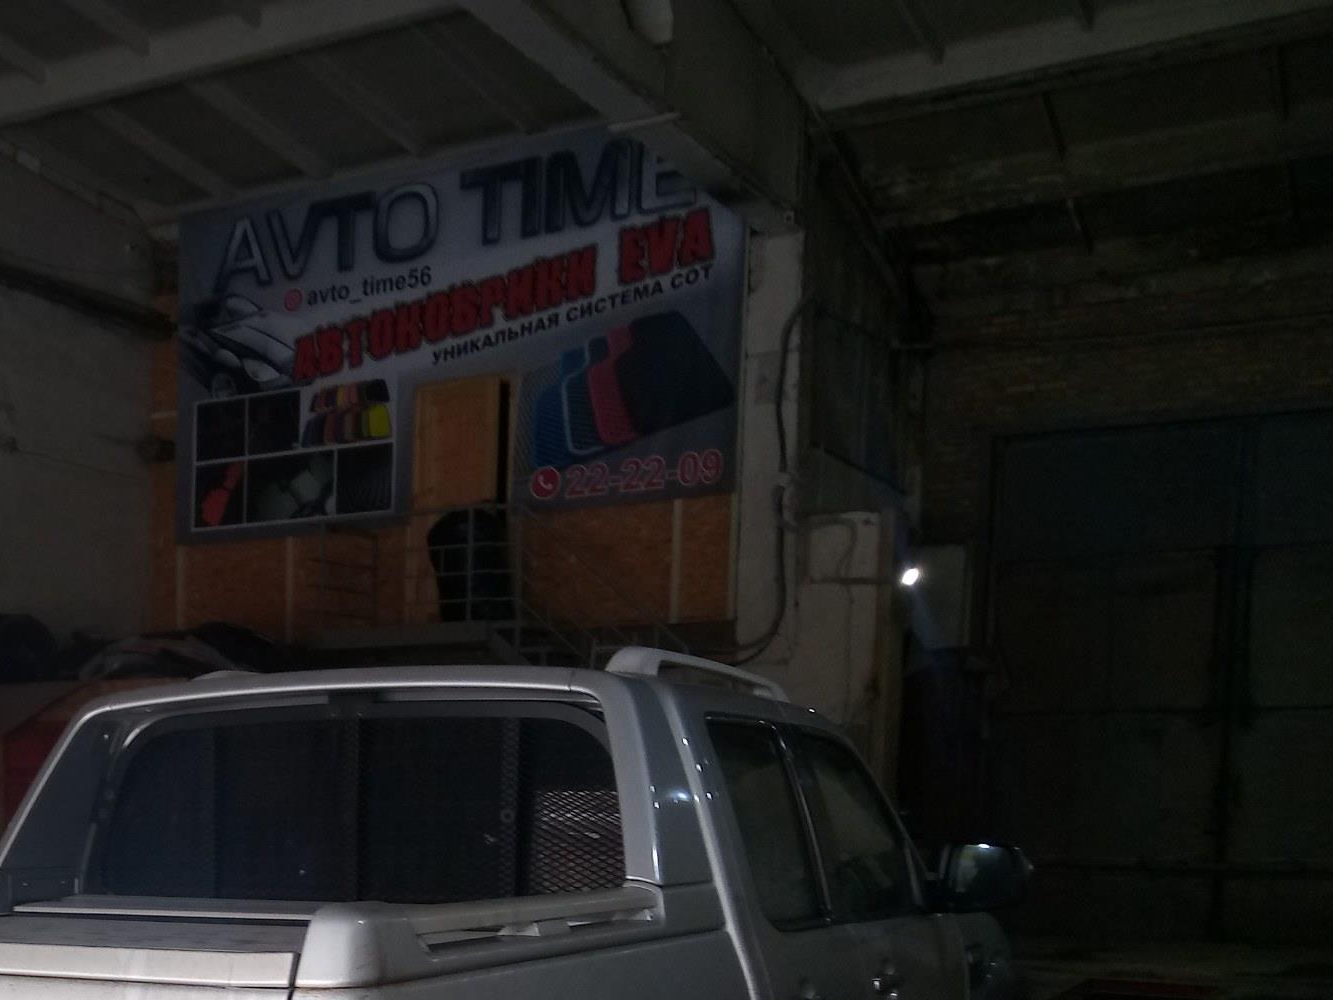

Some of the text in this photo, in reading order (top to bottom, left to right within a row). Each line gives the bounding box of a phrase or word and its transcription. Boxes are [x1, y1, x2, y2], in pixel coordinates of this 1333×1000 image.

[214, 136, 698, 298] AVTO TIME
[292, 206, 715, 385] АВТОКОВРИКИ EVA
[306, 265, 432, 306] avto_time56
[431, 264, 714, 366] УНИКАЛЬНАЯ СИСТЕМА СОТ
[565, 449, 723, 498] 22-22-09
